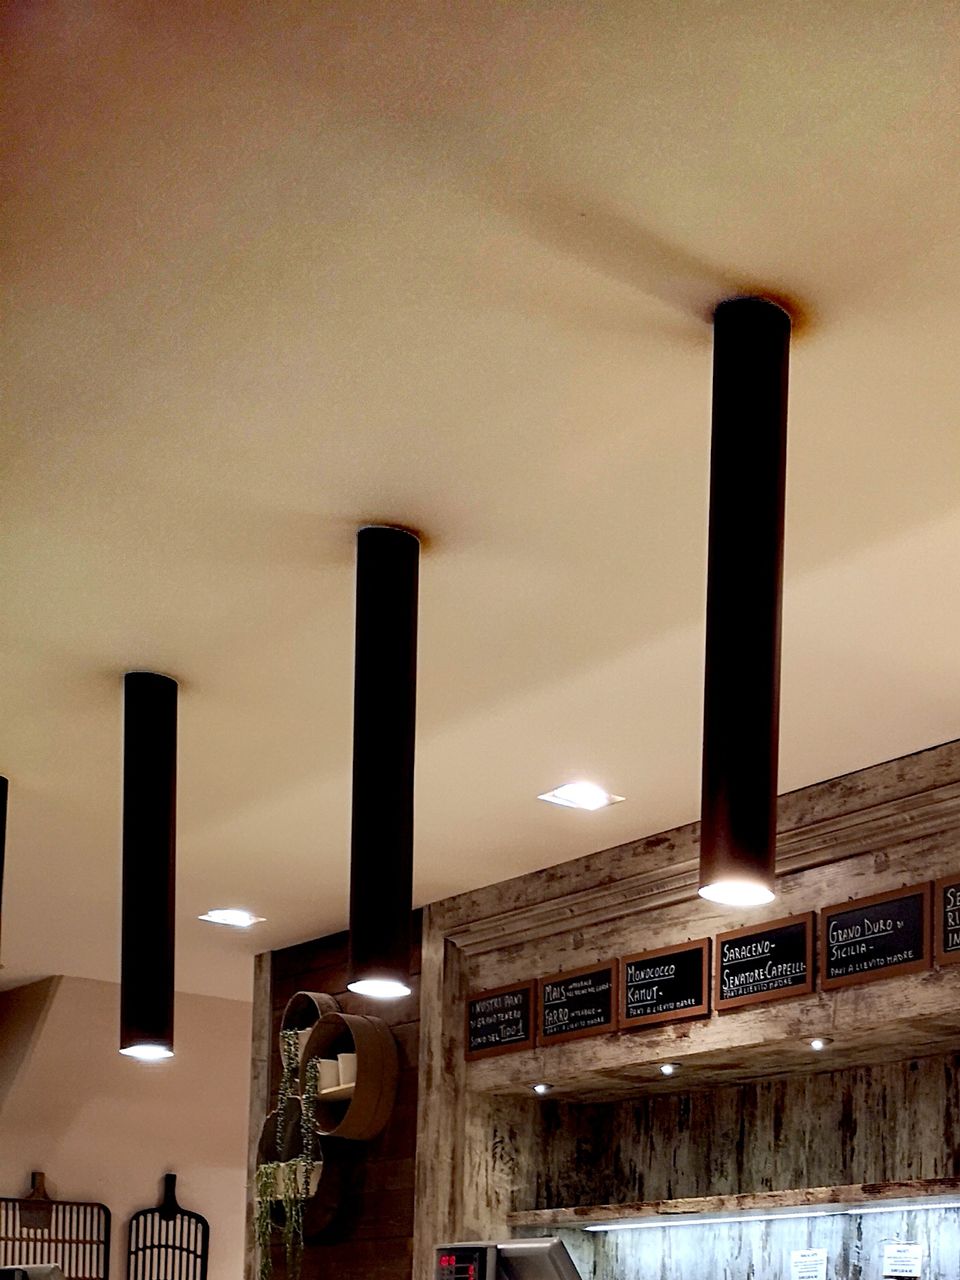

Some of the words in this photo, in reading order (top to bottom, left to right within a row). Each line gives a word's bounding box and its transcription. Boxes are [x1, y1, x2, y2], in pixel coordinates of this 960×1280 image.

[829, 920, 862, 944] GRANO
[864, 919, 893, 936] DURO
[848, 963, 855, 973] A
[855, 957, 886, 972] LIEVITO
[886, 949, 914, 965] MADRE
[544, 984, 567, 1003] MAIS
[544, 1008, 569, 1026] FARRO
